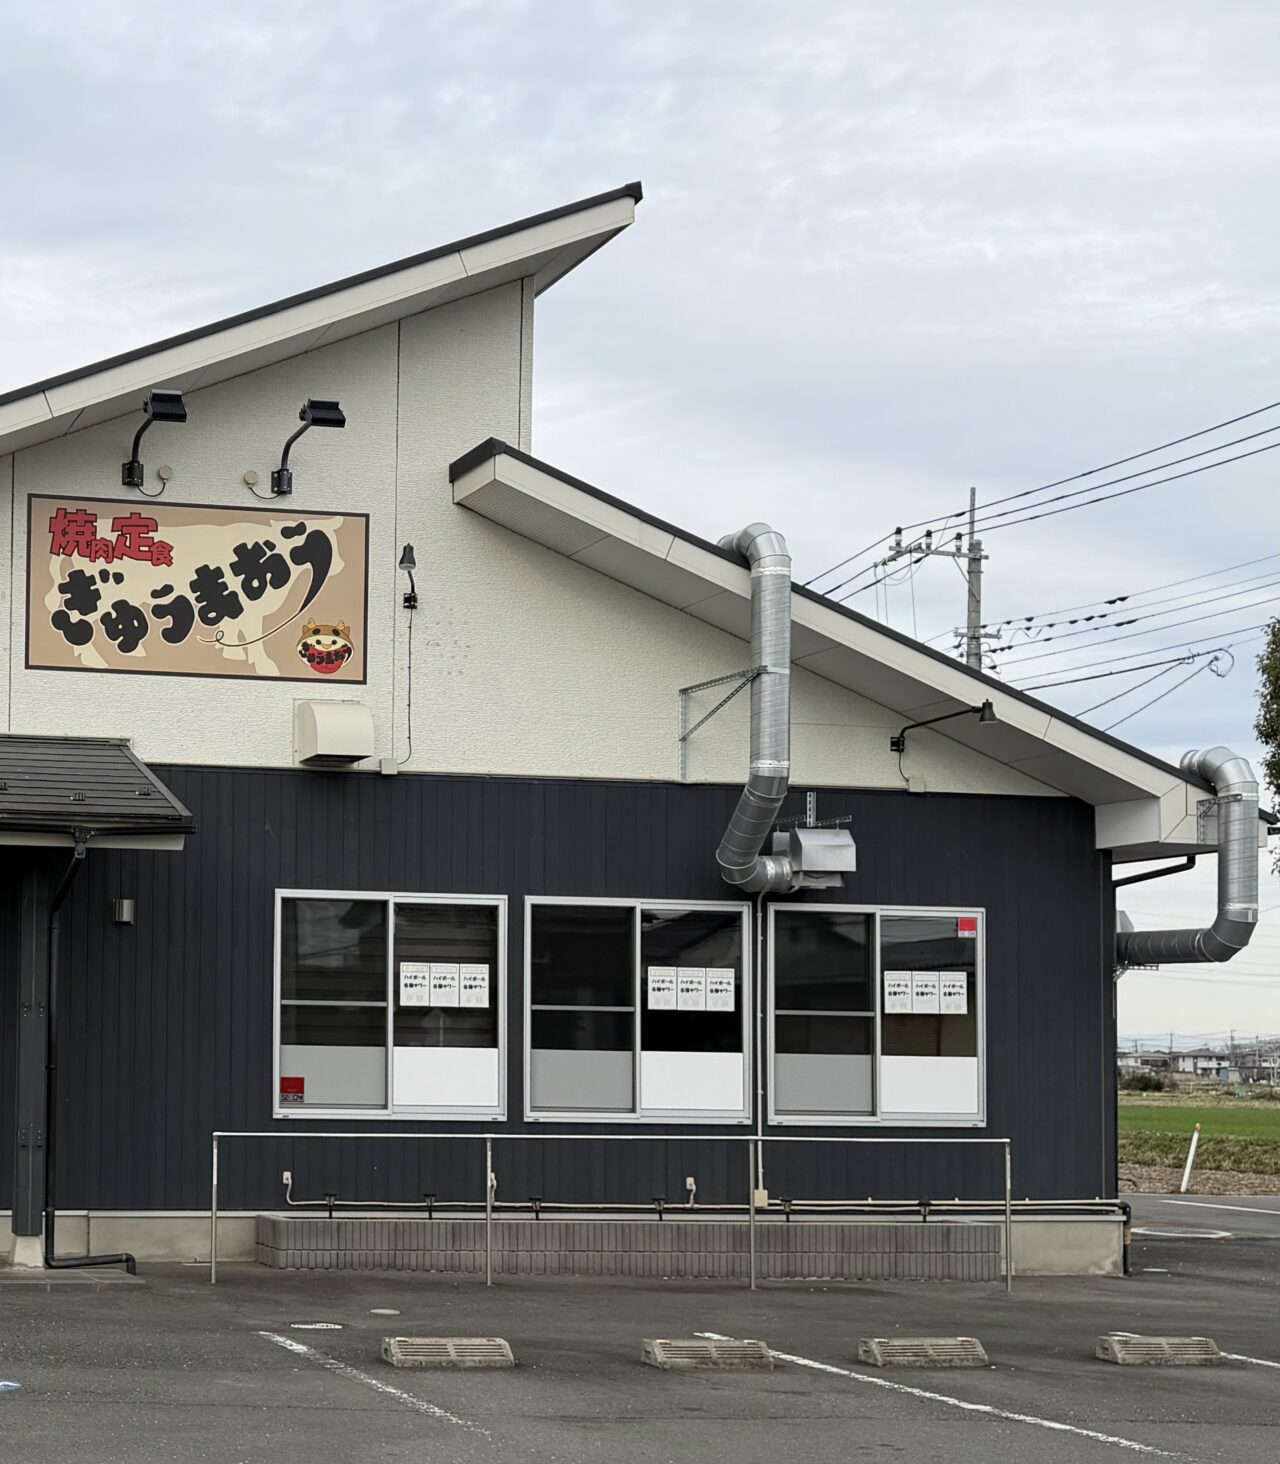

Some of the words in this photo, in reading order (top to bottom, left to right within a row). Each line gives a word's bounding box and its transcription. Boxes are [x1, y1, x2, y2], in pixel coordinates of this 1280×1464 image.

[49, 508, 174, 567] 焼肉定食
[51, 521, 333, 654] ぎゅうまおう
